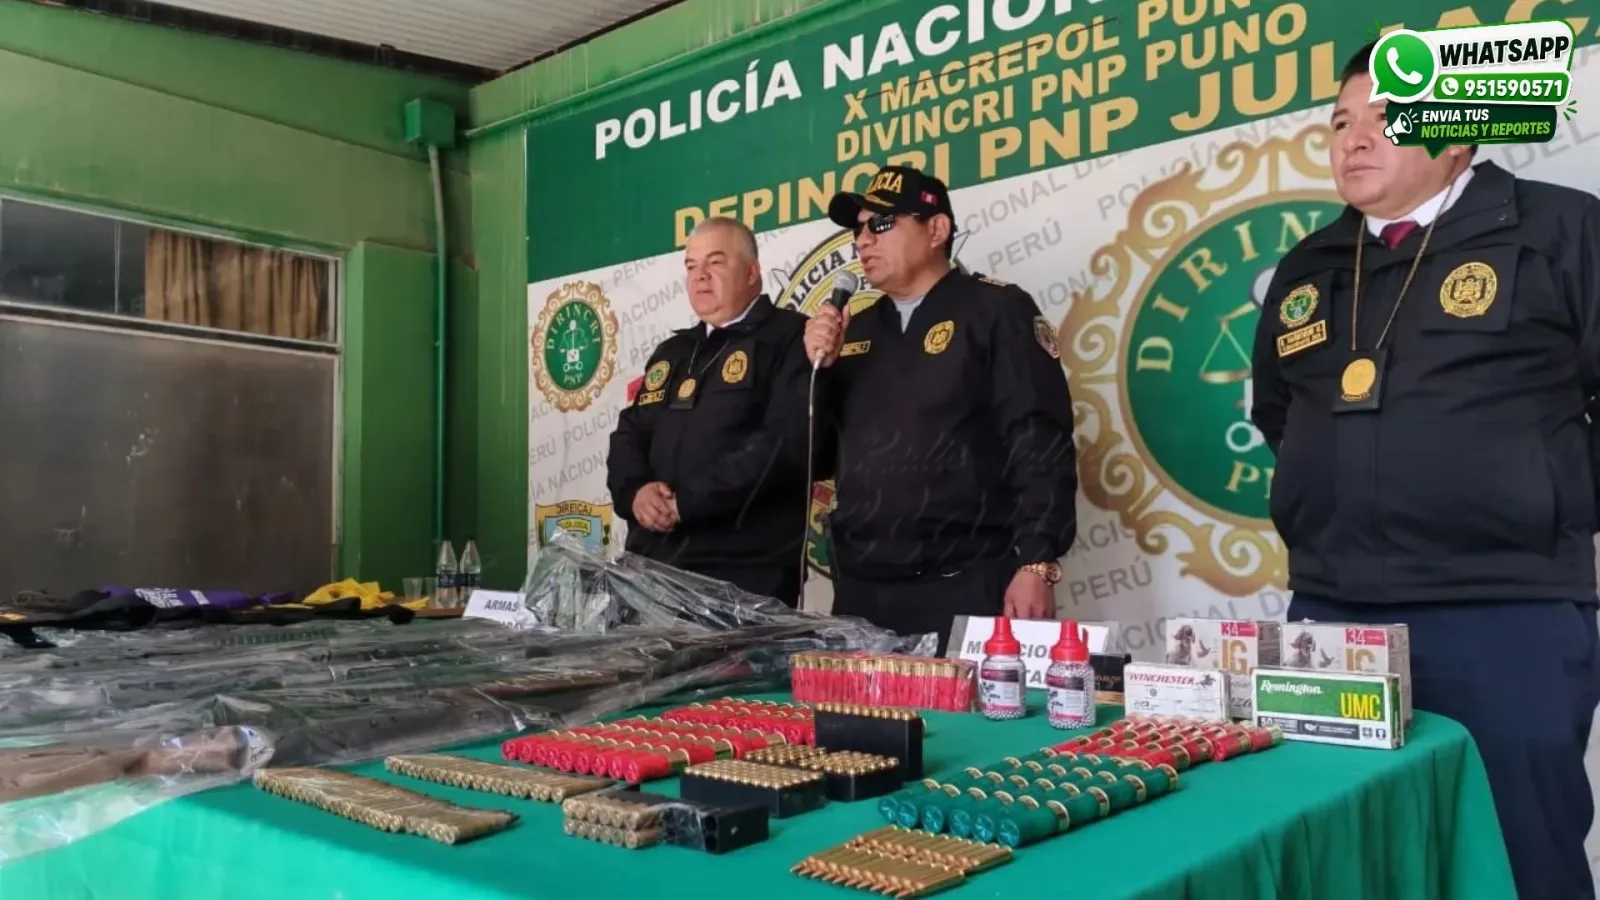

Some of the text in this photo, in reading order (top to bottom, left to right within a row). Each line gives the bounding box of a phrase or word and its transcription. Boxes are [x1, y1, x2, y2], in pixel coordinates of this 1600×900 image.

[837, 3, 1307, 163] DIVINCRI PNP PUNO
[841, 88, 869, 124] X
[880, 15, 1120, 114] MACREPOL
[595, 58, 802, 160] POLICÍA
[980, 97, 1139, 179] PNP
[987, 217, 1063, 275] PERÚ
[547, 302, 601, 350] DIRINCRI
[1069, 556, 1152, 605] PERÚ
[484, 600, 519, 612] ARMAS
[1346, 629, 1365, 645] 34
[1130, 673, 1195, 685] WINCHESTER
[1260, 679, 1323, 695] Remington
[1340, 692, 1381, 721] UMC
